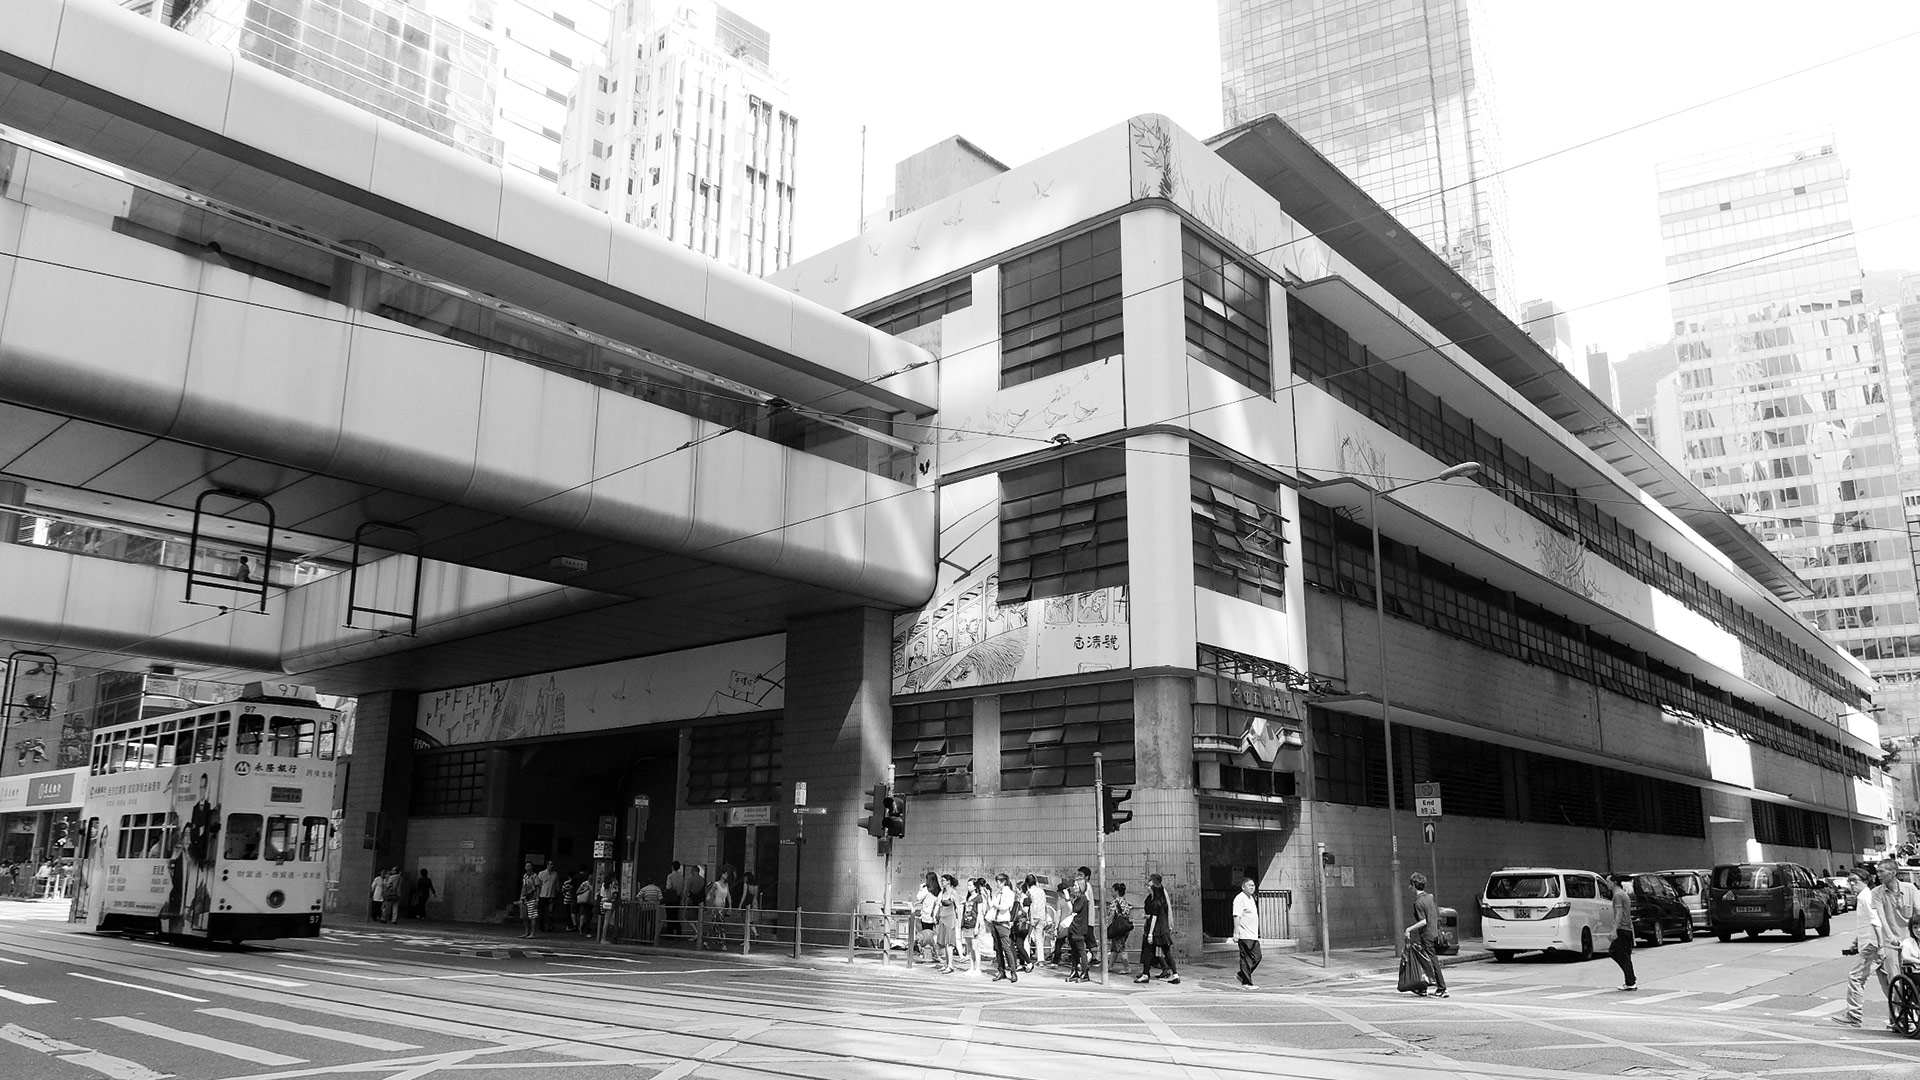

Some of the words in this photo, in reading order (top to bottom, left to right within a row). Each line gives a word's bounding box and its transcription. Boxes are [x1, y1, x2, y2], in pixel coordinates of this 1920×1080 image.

[278, 683, 299, 697] 97
[244, 705, 257, 713] 97
[329, 714, 339, 722] 97
[309, 915, 320, 924] 97
